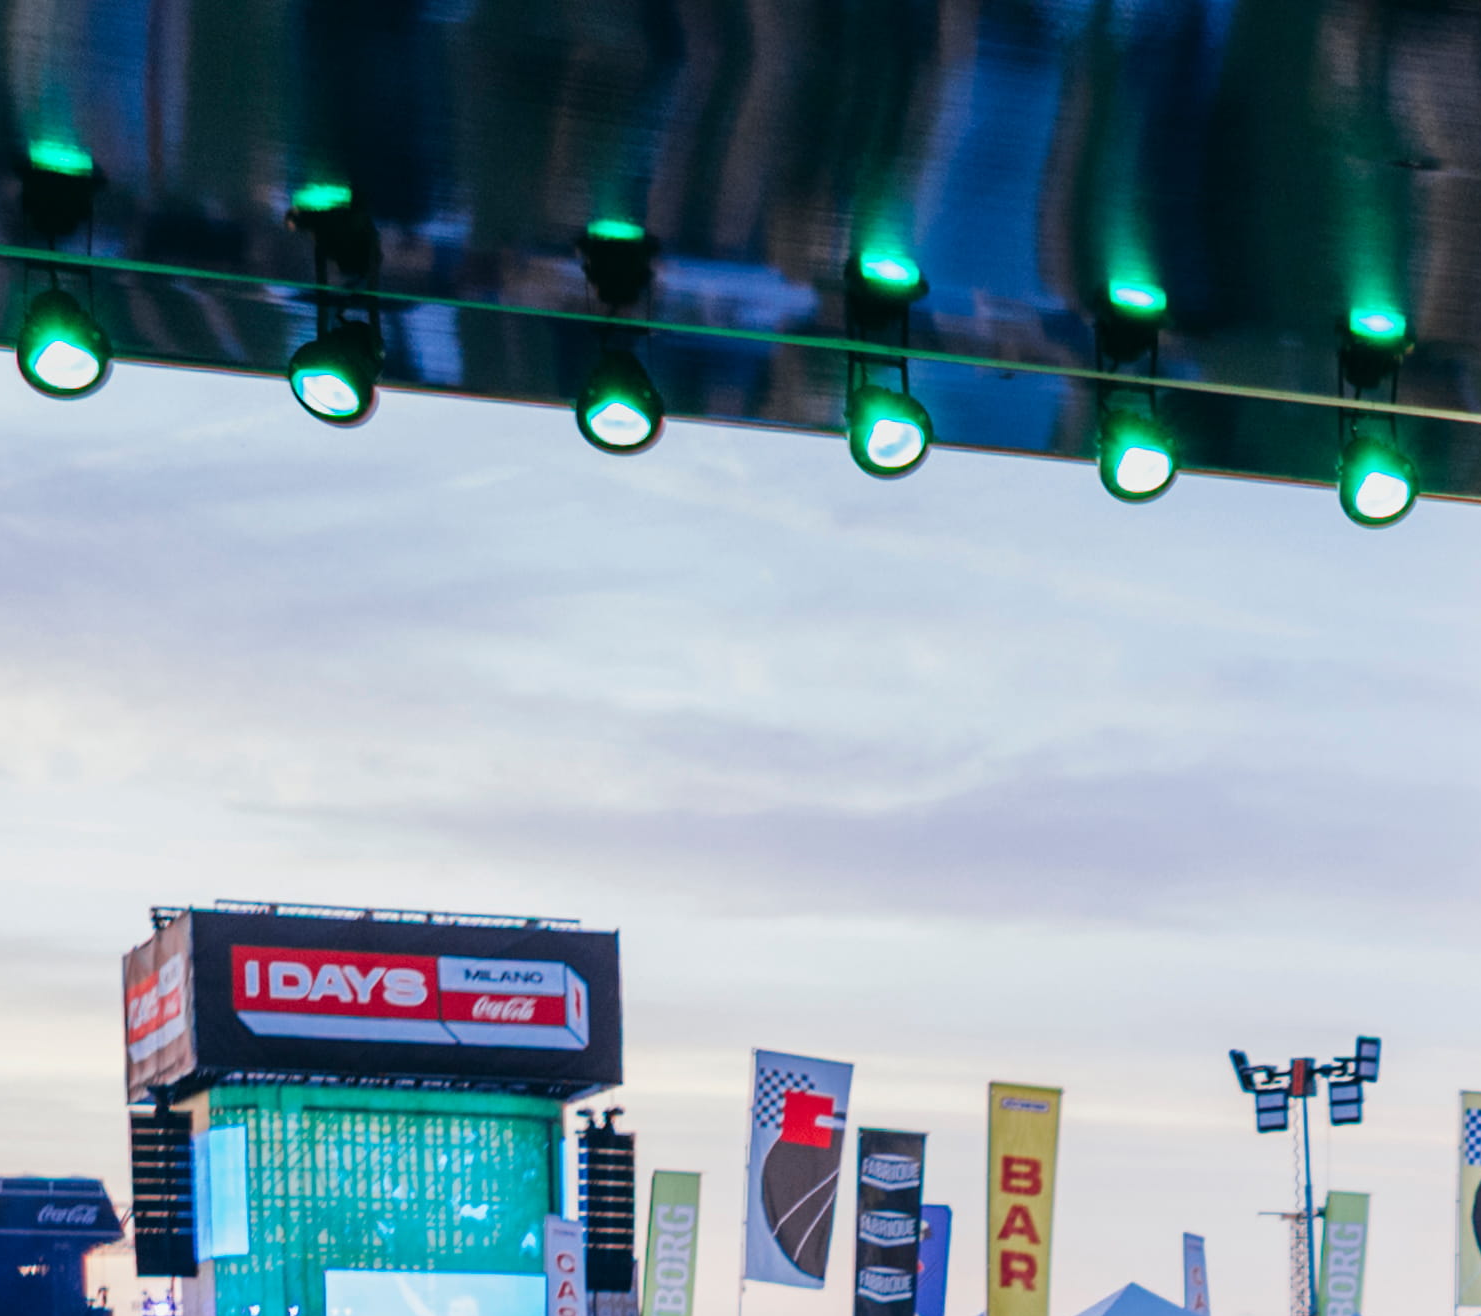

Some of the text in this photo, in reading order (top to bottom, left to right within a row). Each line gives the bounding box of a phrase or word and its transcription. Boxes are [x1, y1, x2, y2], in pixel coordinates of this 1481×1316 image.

[268, 961, 428, 1007] DAYS
[464, 967, 544, 985] MILANO
[861, 1156, 920, 1182] FABRIQUE
[859, 1213, 917, 1239] FABRIQUE
[997, 1154, 1043, 1292] BAR
[858, 1269, 913, 1295] FABRIQUE
